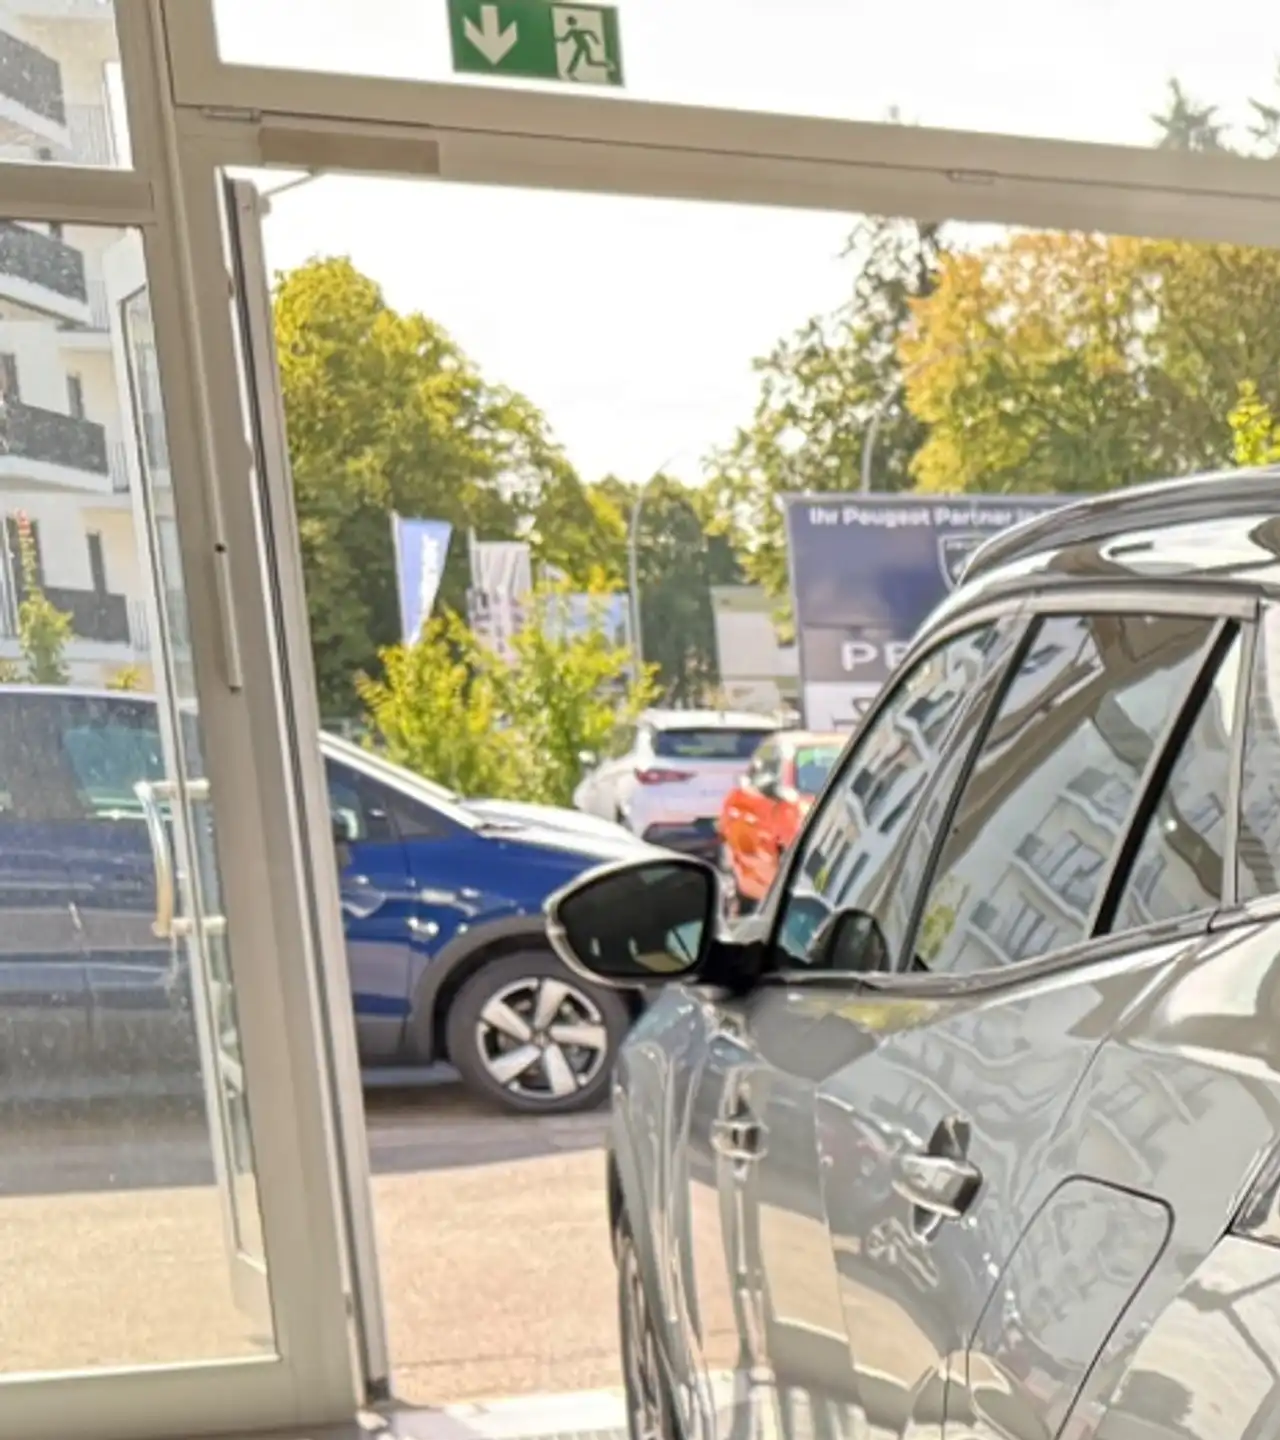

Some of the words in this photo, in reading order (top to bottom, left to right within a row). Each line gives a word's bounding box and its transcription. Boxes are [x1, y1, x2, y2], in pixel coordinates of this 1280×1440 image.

[808, 506, 838, 526] Ihr
[841, 506, 931, 528] Peugeot
[934, 506, 1011, 526] Partner
